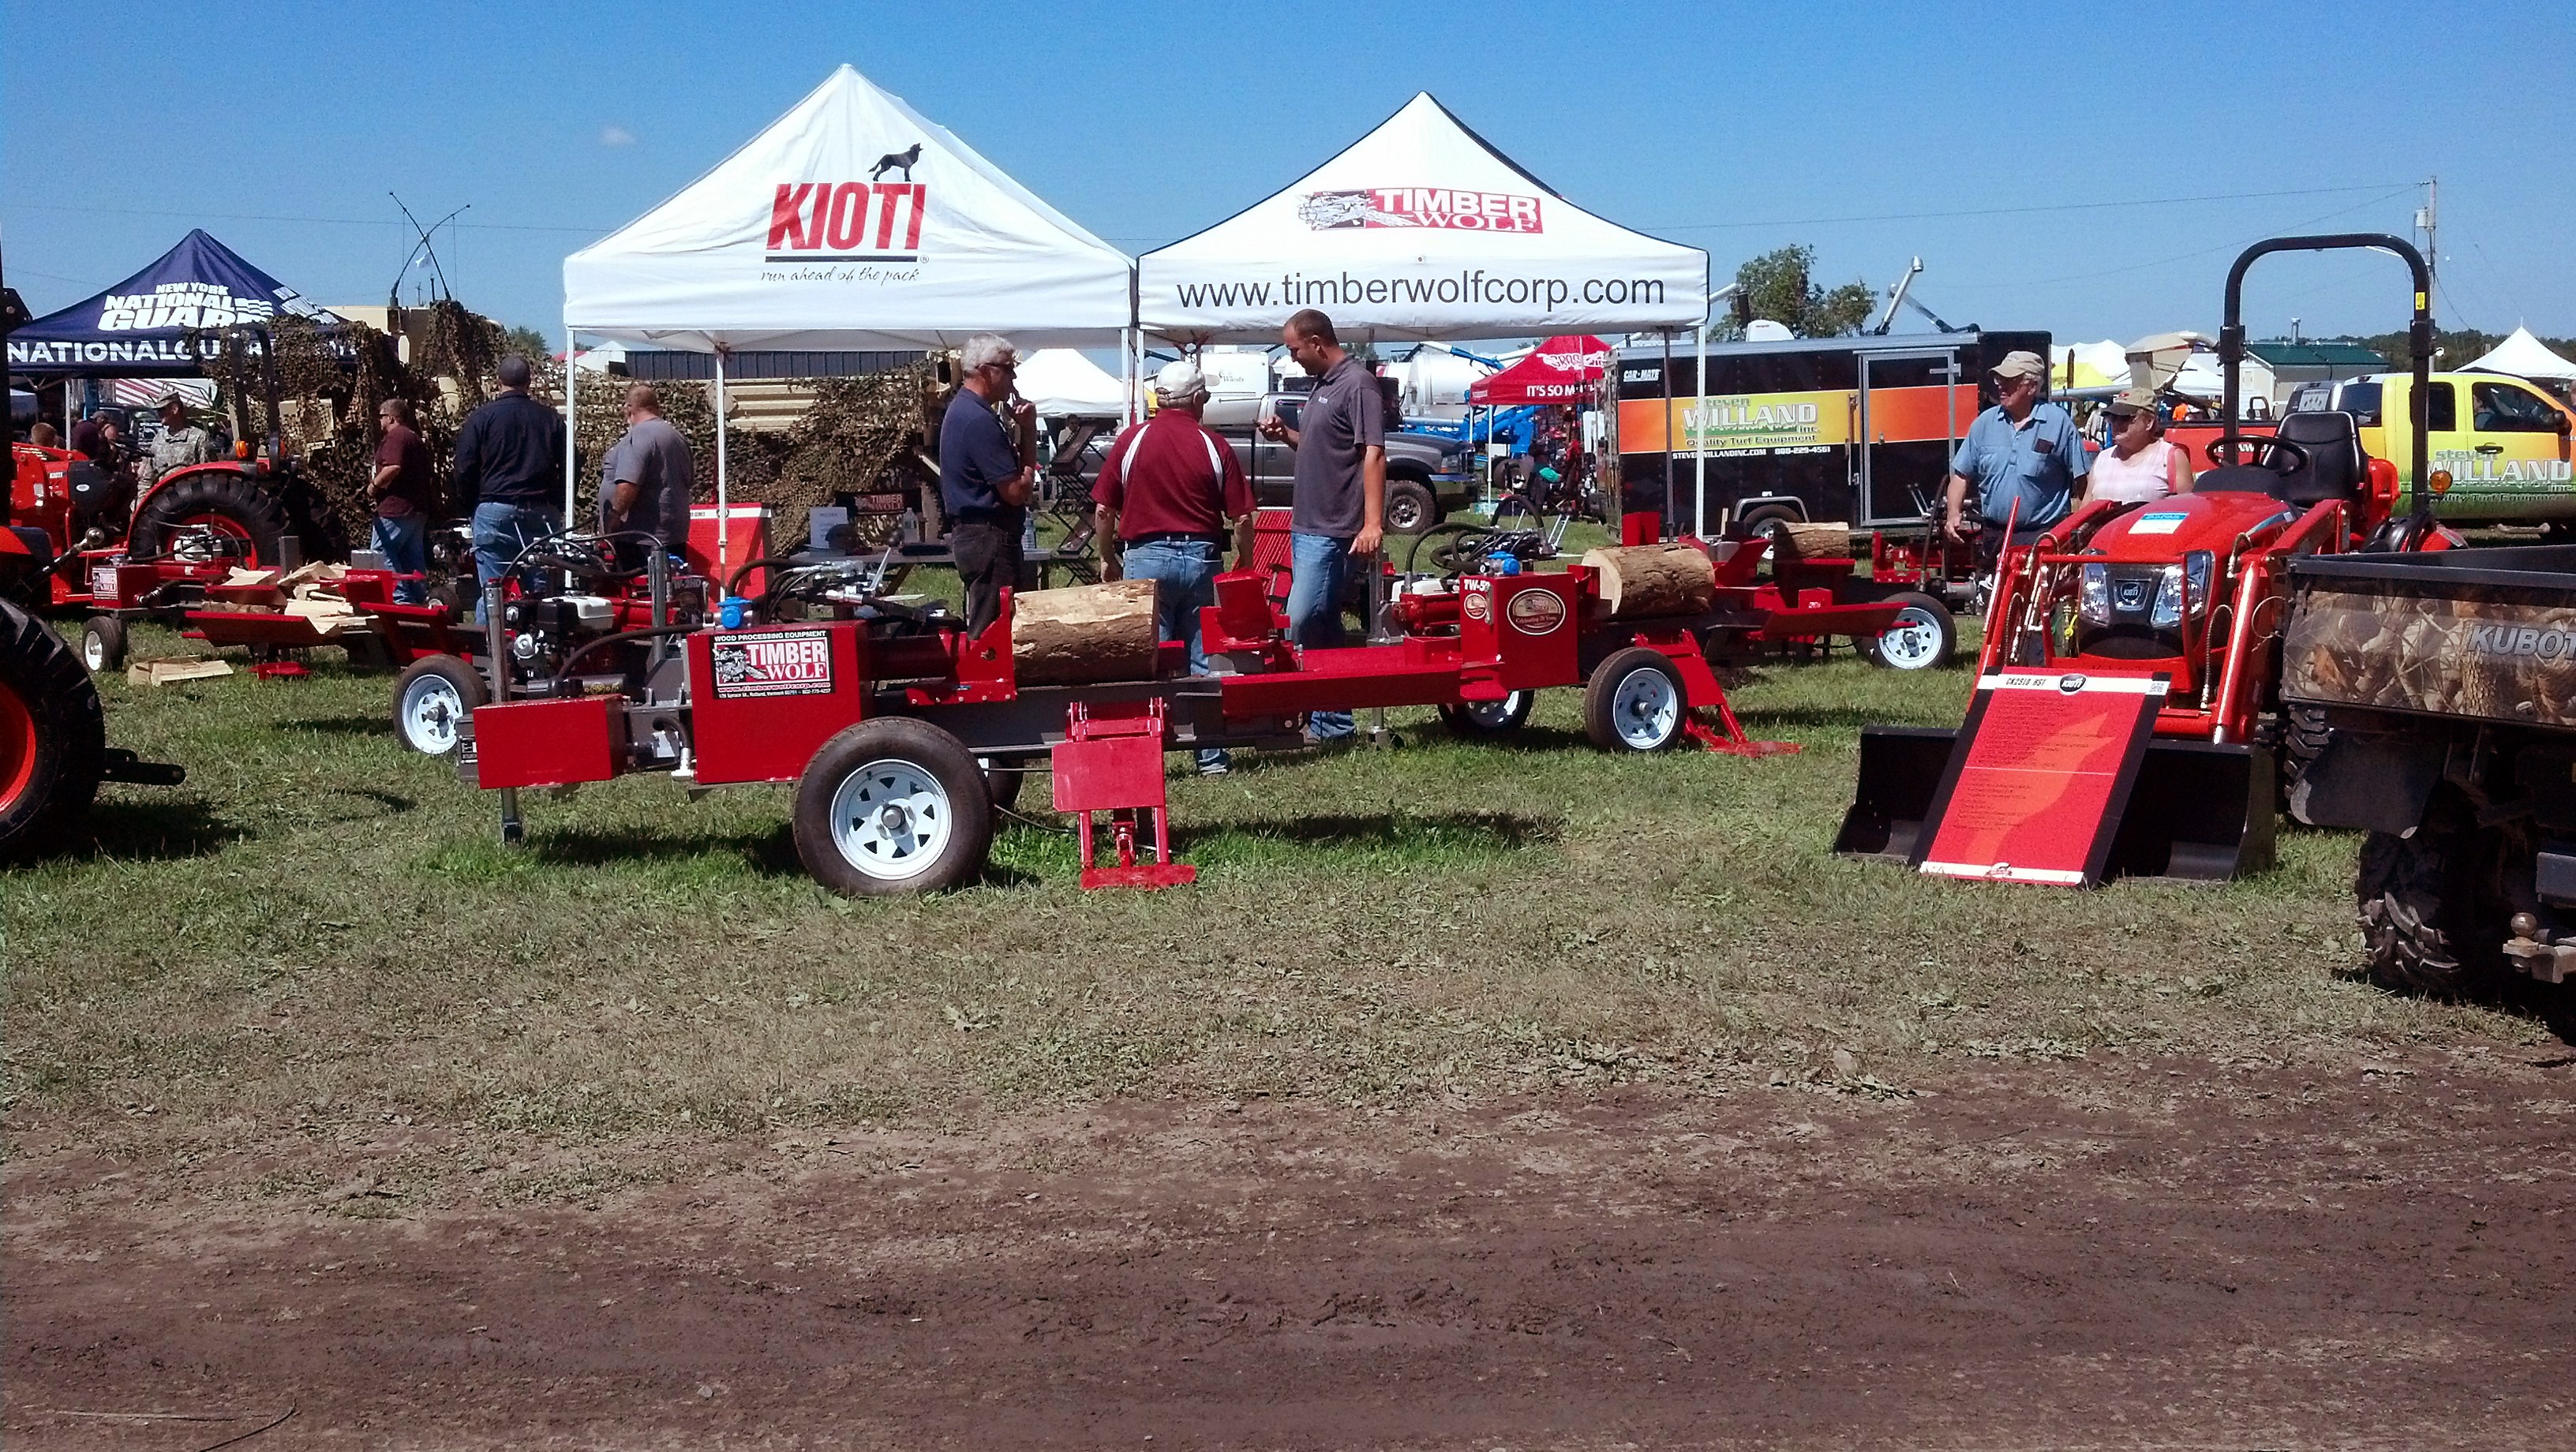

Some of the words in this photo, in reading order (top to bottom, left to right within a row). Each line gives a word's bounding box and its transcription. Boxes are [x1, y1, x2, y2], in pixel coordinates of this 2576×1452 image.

[1375, 188, 1538, 221] TIMBER
[766, 182, 926, 250] KIOTI
[1412, 210, 1537, 233] WOLF
[761, 271, 785, 282] run
[791, 267, 837, 281] ahead
[857, 267, 879, 281] the
[881, 268, 919, 286] pack
[155, 283, 191, 294] NEW
[190, 283, 230, 296] YORK
[1177, 270, 1665, 312] www.timberwolfcorp.com
[103, 292, 235, 311] NATIONAL
[1526, 385, 1546, 397] IT'S
[1548, 384, 1563, 397] SO
[1696, 398, 1750, 407] teven
[1682, 403, 1818, 427] WILLAND
[1686, 438, 1727, 448] Qality
[1755, 434, 1817, 444] Equipment
[747, 642, 826, 665] TIMBER
[766, 663, 826, 679] WOLF
